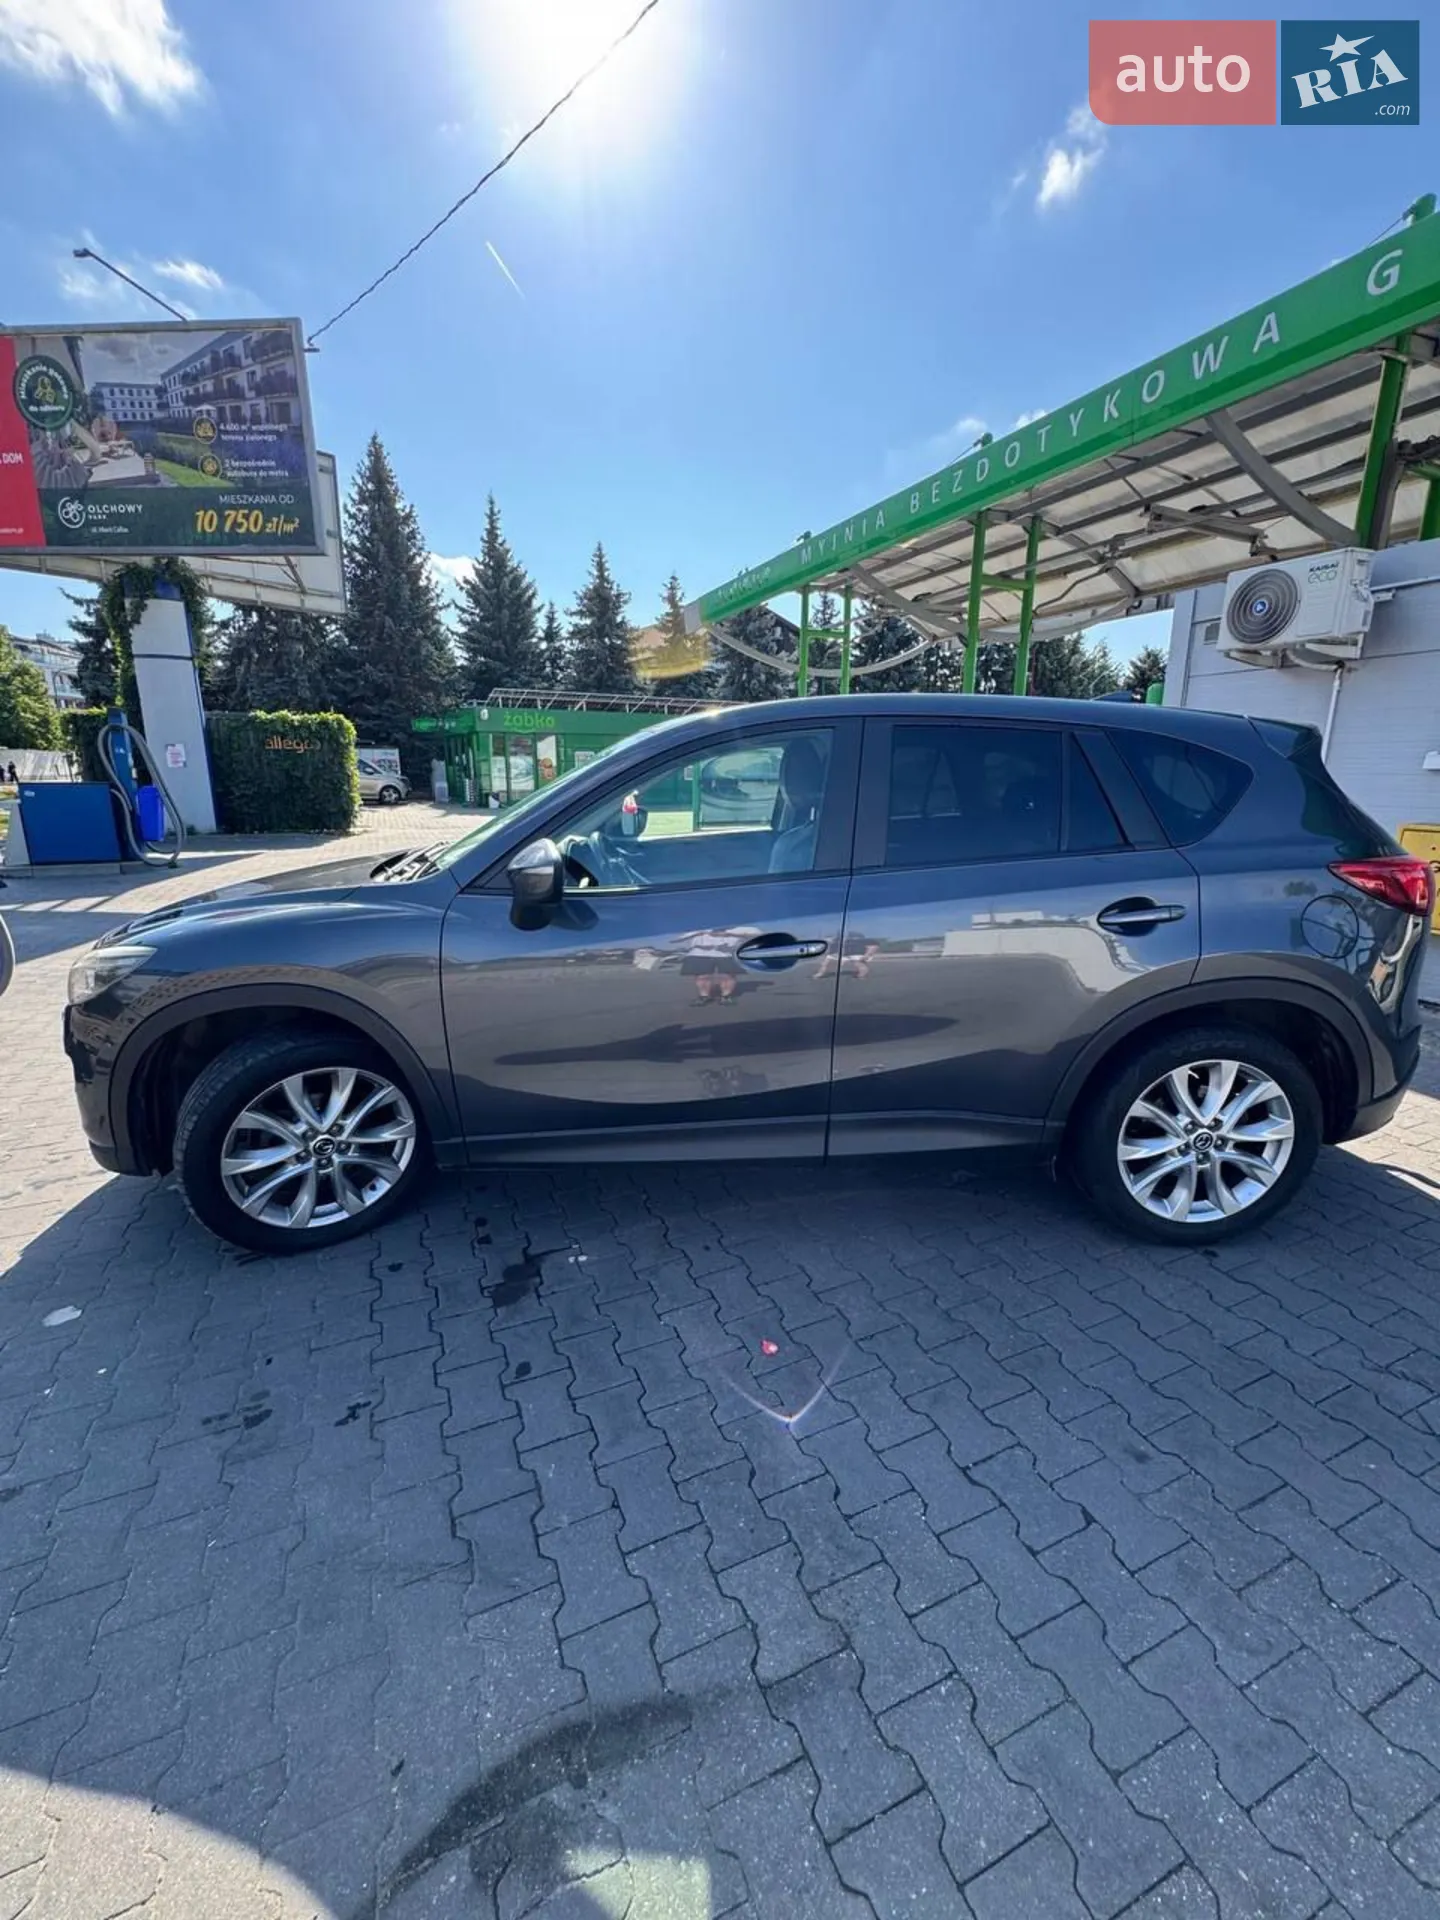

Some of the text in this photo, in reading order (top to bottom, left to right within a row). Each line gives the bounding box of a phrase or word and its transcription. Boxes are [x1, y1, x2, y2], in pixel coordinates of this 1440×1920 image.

[801, 248, 1403, 565] MYJNIA BEZDOTYKOWA G
[2, 452, 24, 464] DOM
[219, 494, 295, 504] MIESZKANIA OD
[87, 503, 143, 514] OLCHOWY
[195, 509, 218, 533] 10
[224, 509, 264, 533] 750
[1308, 569, 1338, 584] eco
[504, 711, 556, 728] żabka
